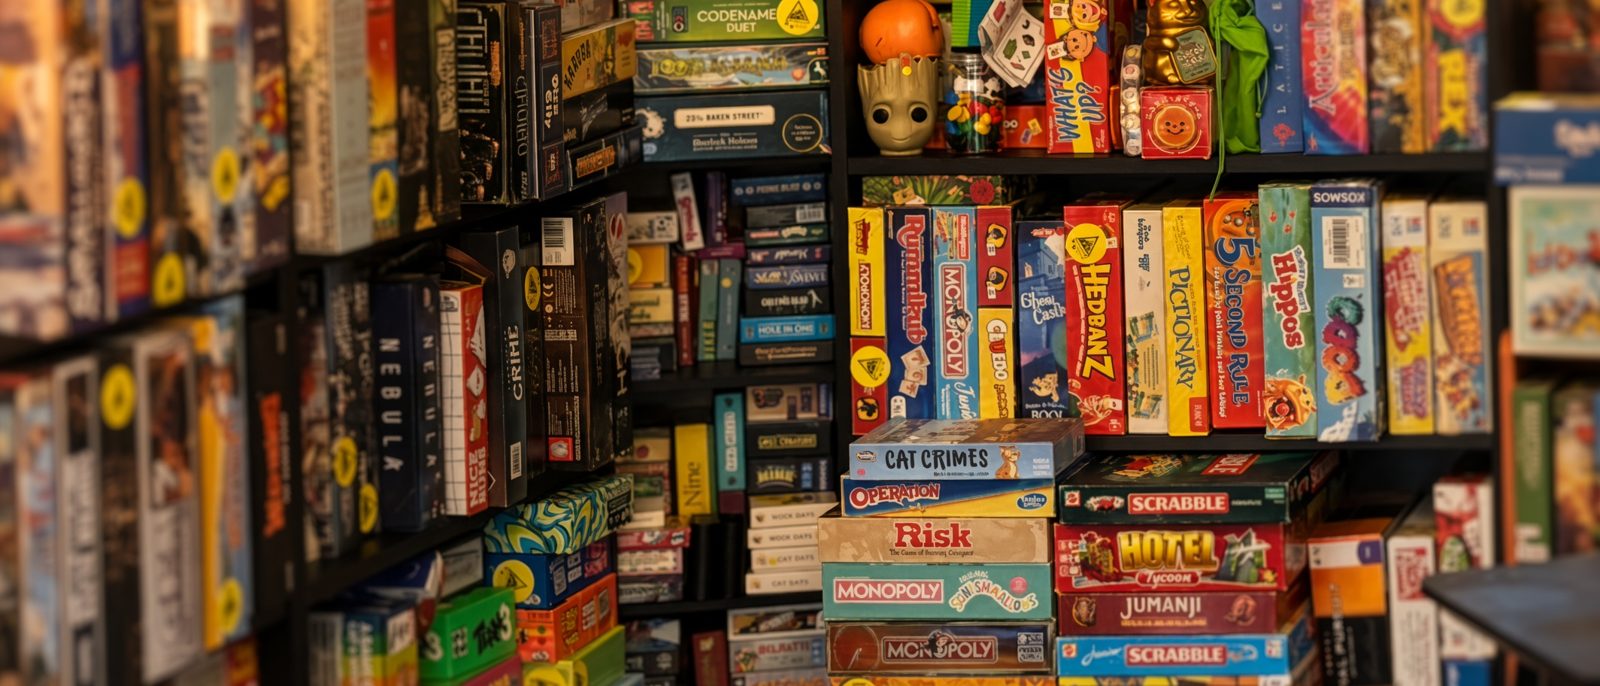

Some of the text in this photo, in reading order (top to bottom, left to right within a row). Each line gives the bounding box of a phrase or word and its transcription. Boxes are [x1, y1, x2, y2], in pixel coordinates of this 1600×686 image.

[726, 22, 757, 33] DUET
[1075, 81, 1106, 124] UP?
[1313, 192, 1366, 203] SOWSOX
[1169, 265, 1197, 389] PICTIONARY
[1214, 237, 1256, 405] 5 SECOND RULE
[380, 338, 403, 471] NEBULA
[885, 448, 988, 470] CAT CRIMES
[850, 483, 940, 509] OPERATION
[1132, 496, 1226, 511] SCRABBLE
[1118, 531, 1219, 572] HOTEL
[837, 582, 941, 599] MONOPOLY
[1120, 597, 1201, 619] JUMANJI
[886, 641, 993, 659] MONOPOLY
[1129, 647, 1224, 662] SCRABBLE
